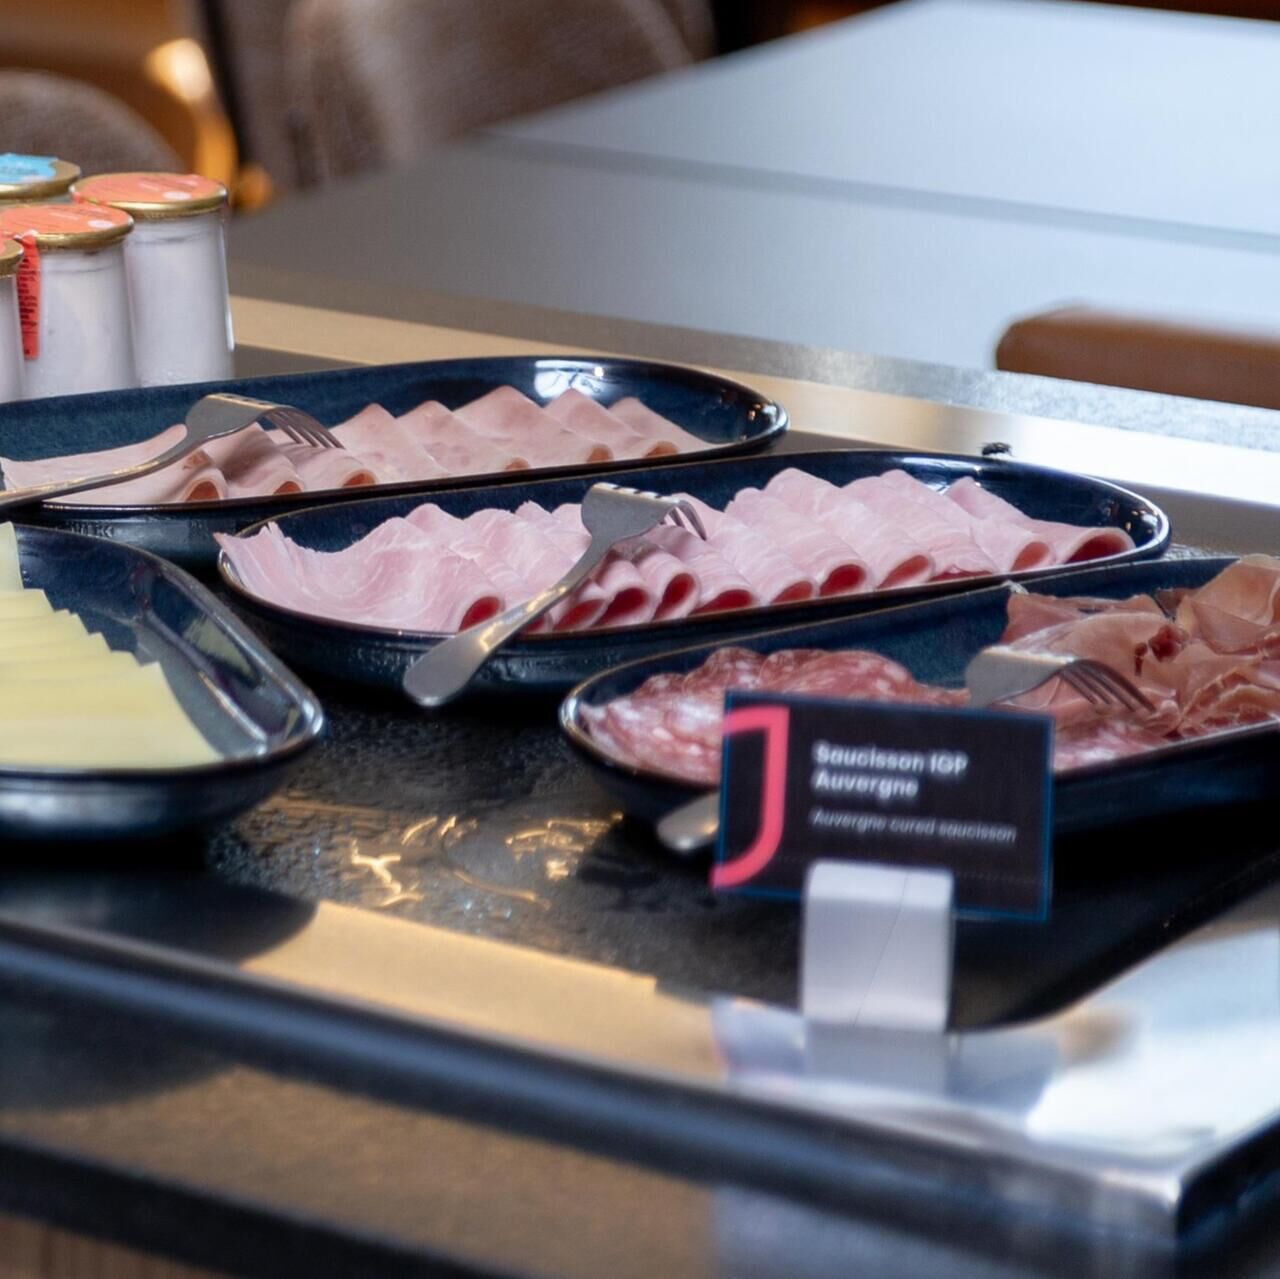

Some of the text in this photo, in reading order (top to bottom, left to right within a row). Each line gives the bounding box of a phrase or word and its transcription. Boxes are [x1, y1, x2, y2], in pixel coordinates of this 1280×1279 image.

[814, 741, 969, 775] Saucisson IGP
[813, 770, 919, 800] Auvergne
[811, 809, 1017, 843] Auvergne cured saucisson
